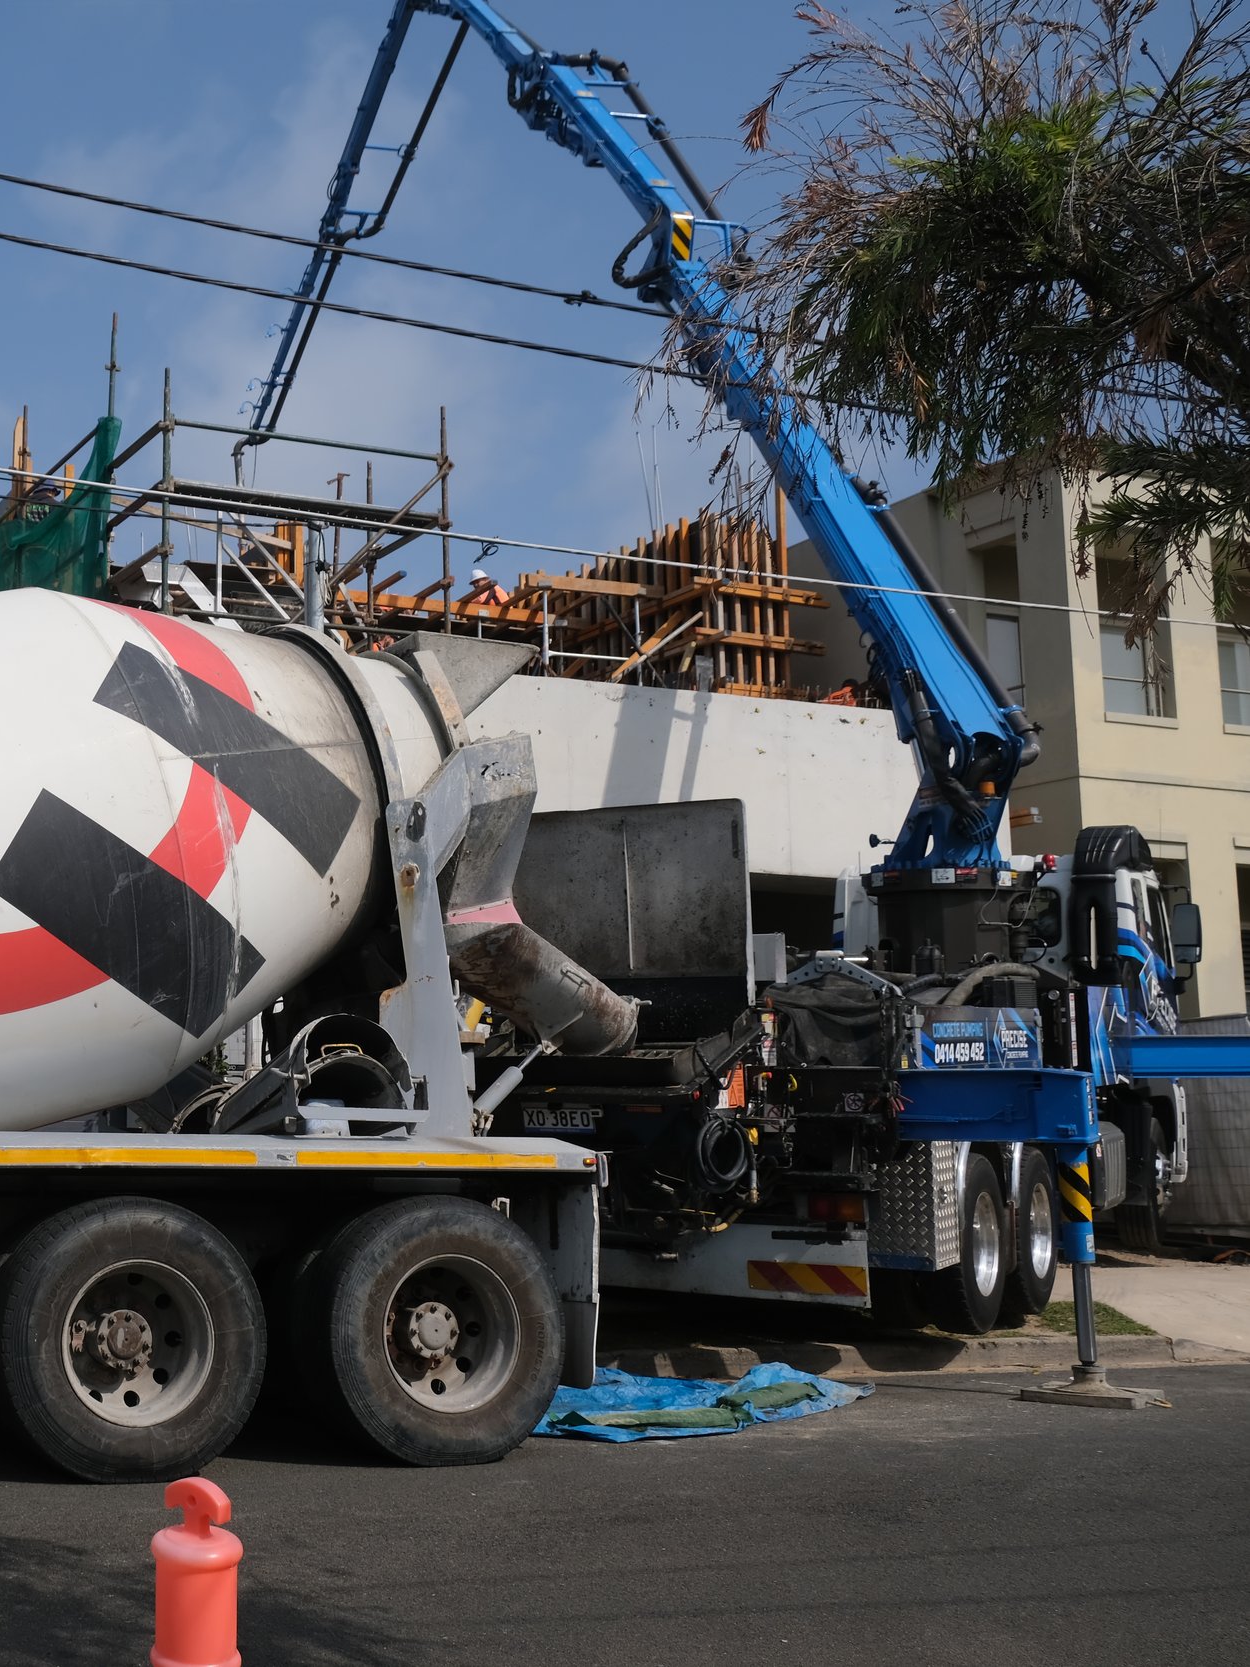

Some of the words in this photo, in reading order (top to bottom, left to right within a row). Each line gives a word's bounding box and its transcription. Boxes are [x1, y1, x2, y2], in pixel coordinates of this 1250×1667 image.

[932, 1023, 960, 1038] CONCRETE
[961, 1022, 984, 1037] PUMPING
[1001, 1030, 1028, 1048] PRECISE
[934, 1043, 955, 1064] 0414
[955, 1042, 970, 1062] 459
[970, 1042, 985, 1061] 452
[531, 1321, 546, 1384] ROBUSTO
